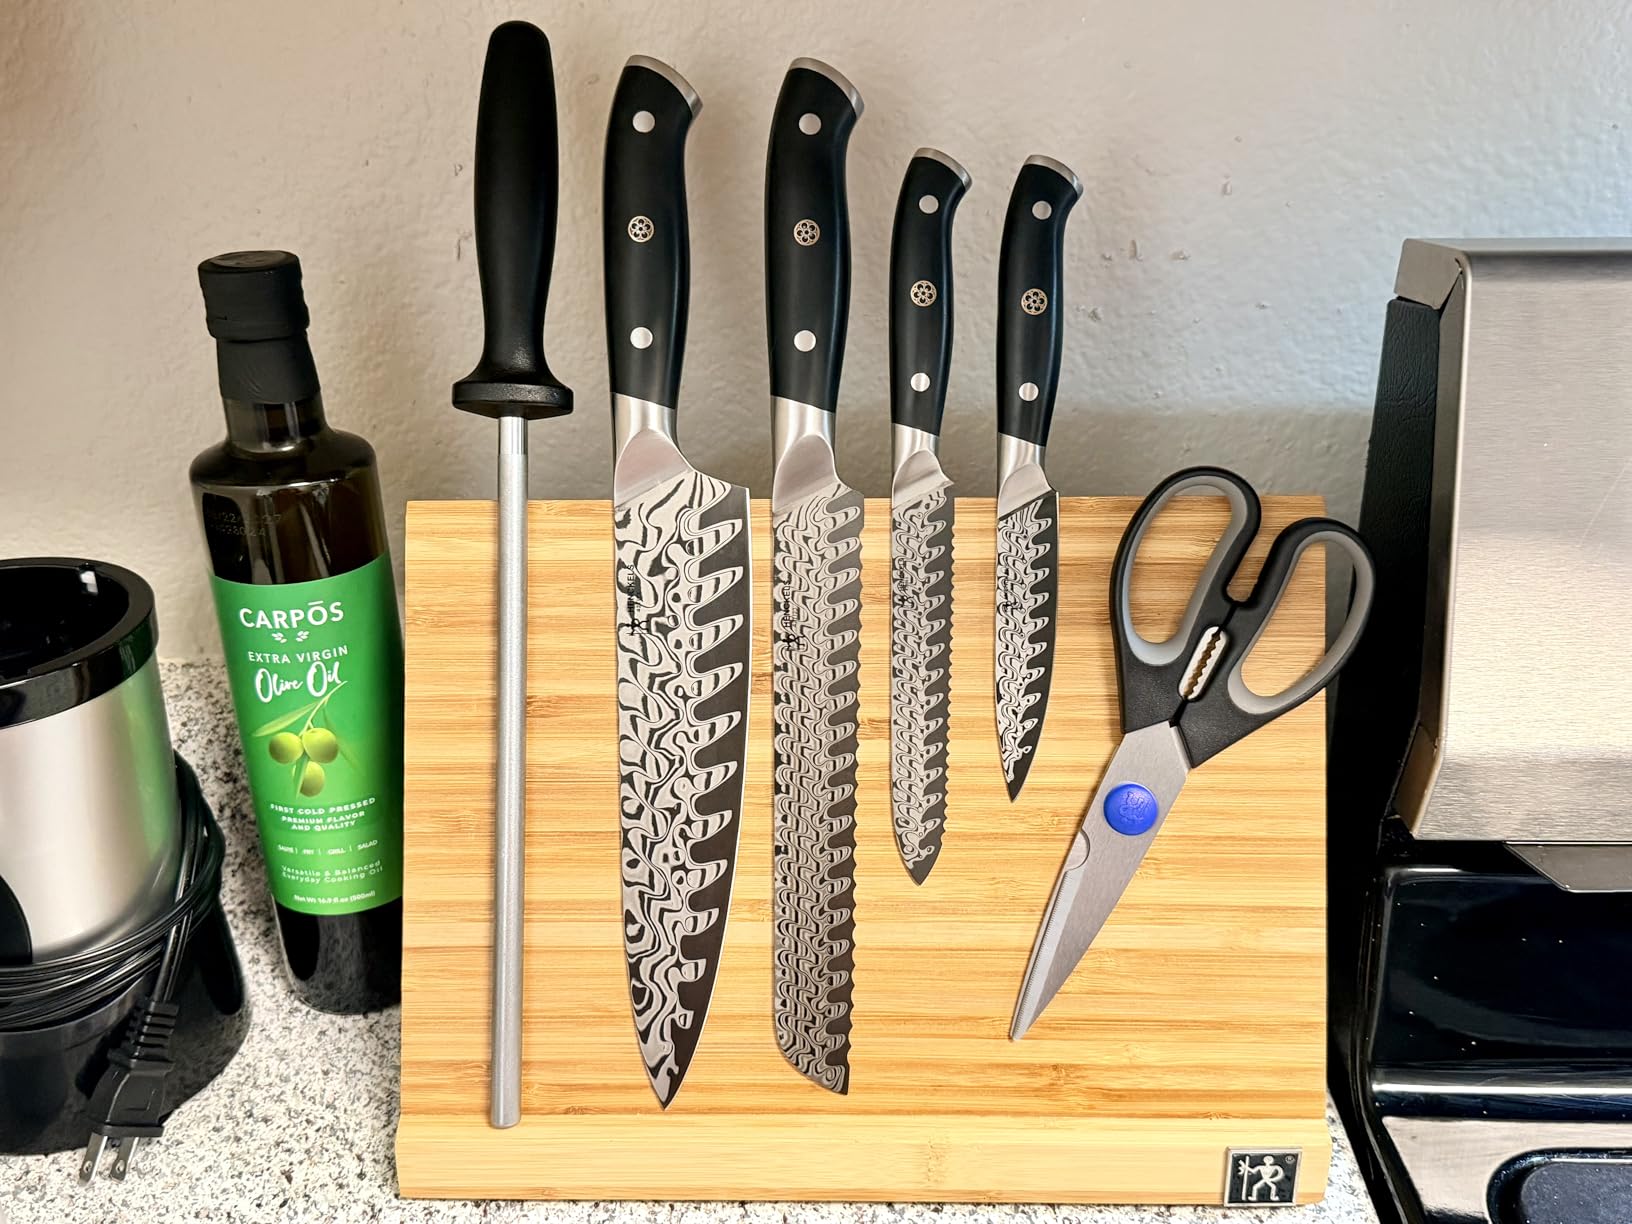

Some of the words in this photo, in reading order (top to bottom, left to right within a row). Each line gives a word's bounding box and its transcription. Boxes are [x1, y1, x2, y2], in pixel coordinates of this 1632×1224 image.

[239, 600, 344, 629] CARPŌS
[248, 651, 291, 664] EXTRA
[296, 645, 348, 663] VIRGIN
[255, 668, 303, 703] Olive
[306, 661, 342, 697] Oil
[270, 803, 294, 814] FIRST
[297, 808, 325, 816] COLD
[328, 797, 376, 814] PRESSED
[281, 815, 323, 825] PREMIUM
[327, 810, 365, 823] FLAVOR
[291, 824, 311, 832] AND
[314, 820, 356, 832] QUALITY
[357, 839, 378, 851] SALAD
[281, 865, 321, 877] Versatile
[335, 860, 380, 876] Balanced
[282, 871, 321, 884] Everyday
[324, 872, 366, 884] Cooking
[369, 866, 383, 875] Oil
